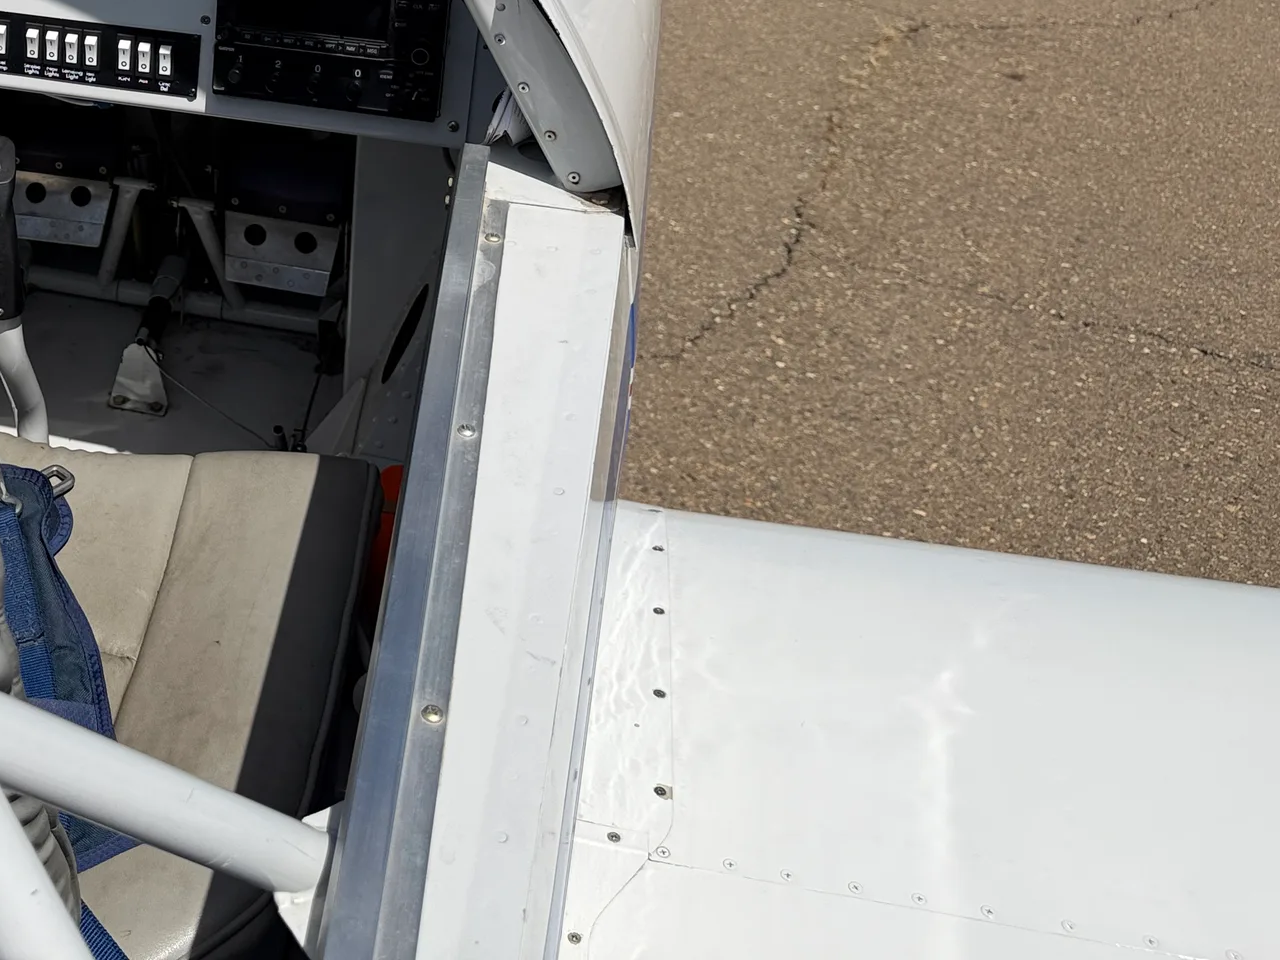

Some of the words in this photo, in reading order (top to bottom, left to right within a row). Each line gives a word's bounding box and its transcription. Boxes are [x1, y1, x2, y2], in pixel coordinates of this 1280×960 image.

[238, 55, 242, 63] 1
[275, 60, 281, 68] 2
[62, 68, 83, 76] Landing
